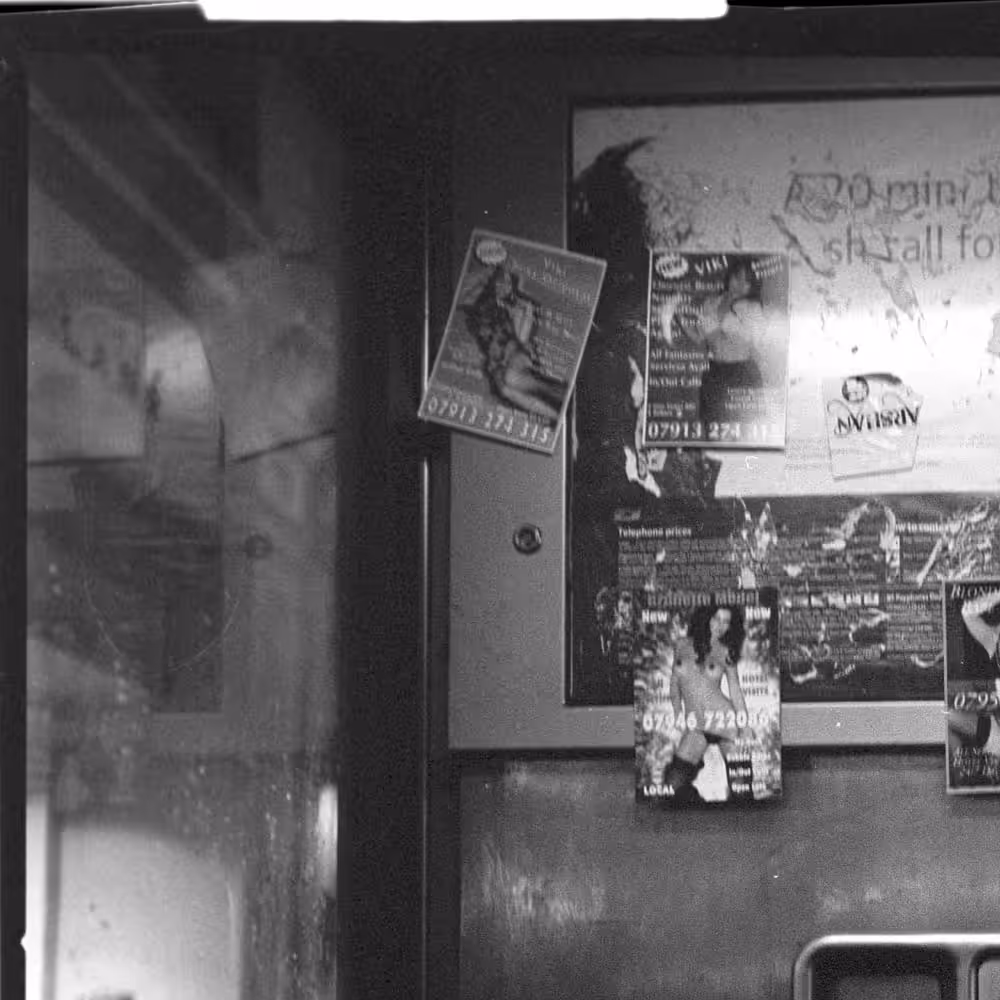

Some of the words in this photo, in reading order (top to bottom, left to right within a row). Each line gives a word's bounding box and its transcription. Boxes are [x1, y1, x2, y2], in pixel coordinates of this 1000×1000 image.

[427, 396, 478, 425] 07913
[647, 421, 702, 440] 07913
[618, 527, 664, 539] Telephone
[665, 527, 692, 539] prices
